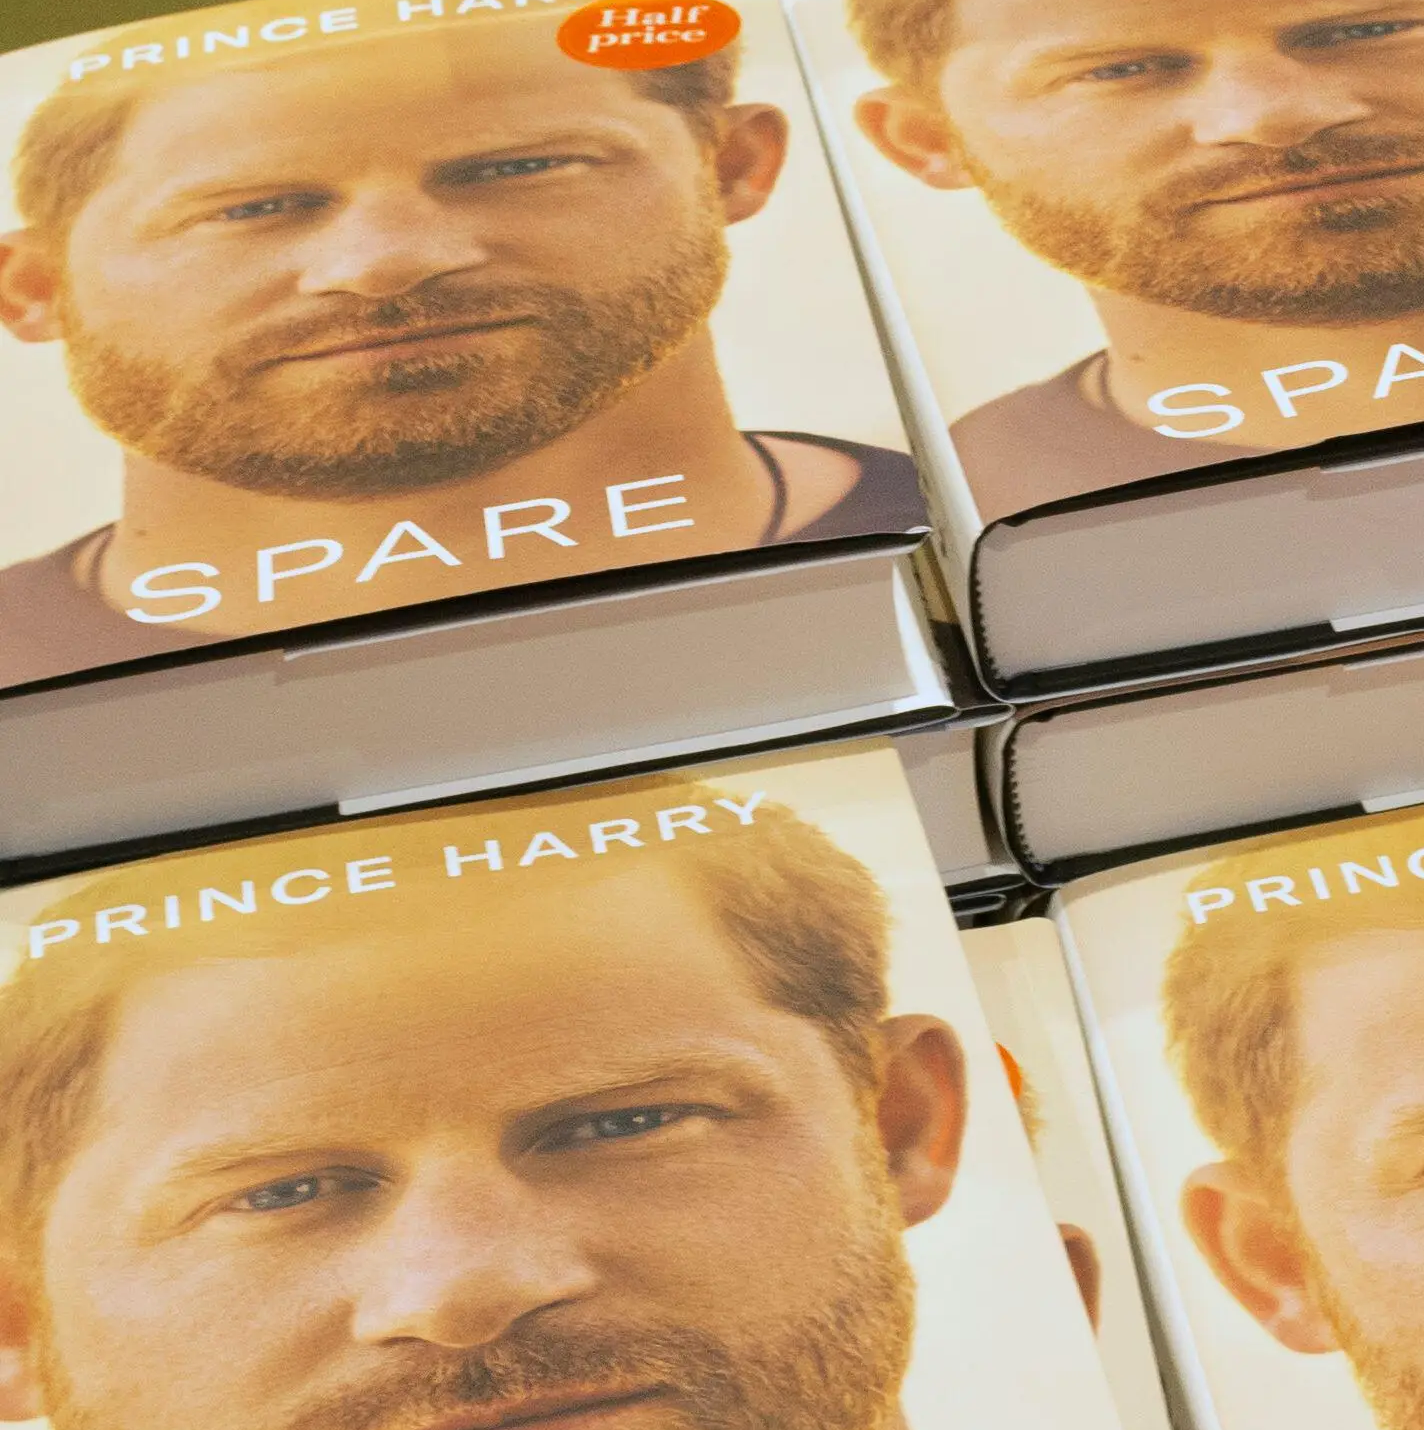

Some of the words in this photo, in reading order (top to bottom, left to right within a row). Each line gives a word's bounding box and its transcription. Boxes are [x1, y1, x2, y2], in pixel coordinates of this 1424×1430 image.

[70, 7, 358, 81] PRINCE
[587, 26, 707, 53] price
[598, 6, 710, 27] Half
[125, 473, 695, 624] SPARE
[28, 856, 396, 959] PRINCE
[444, 791, 766, 877] HARRY
